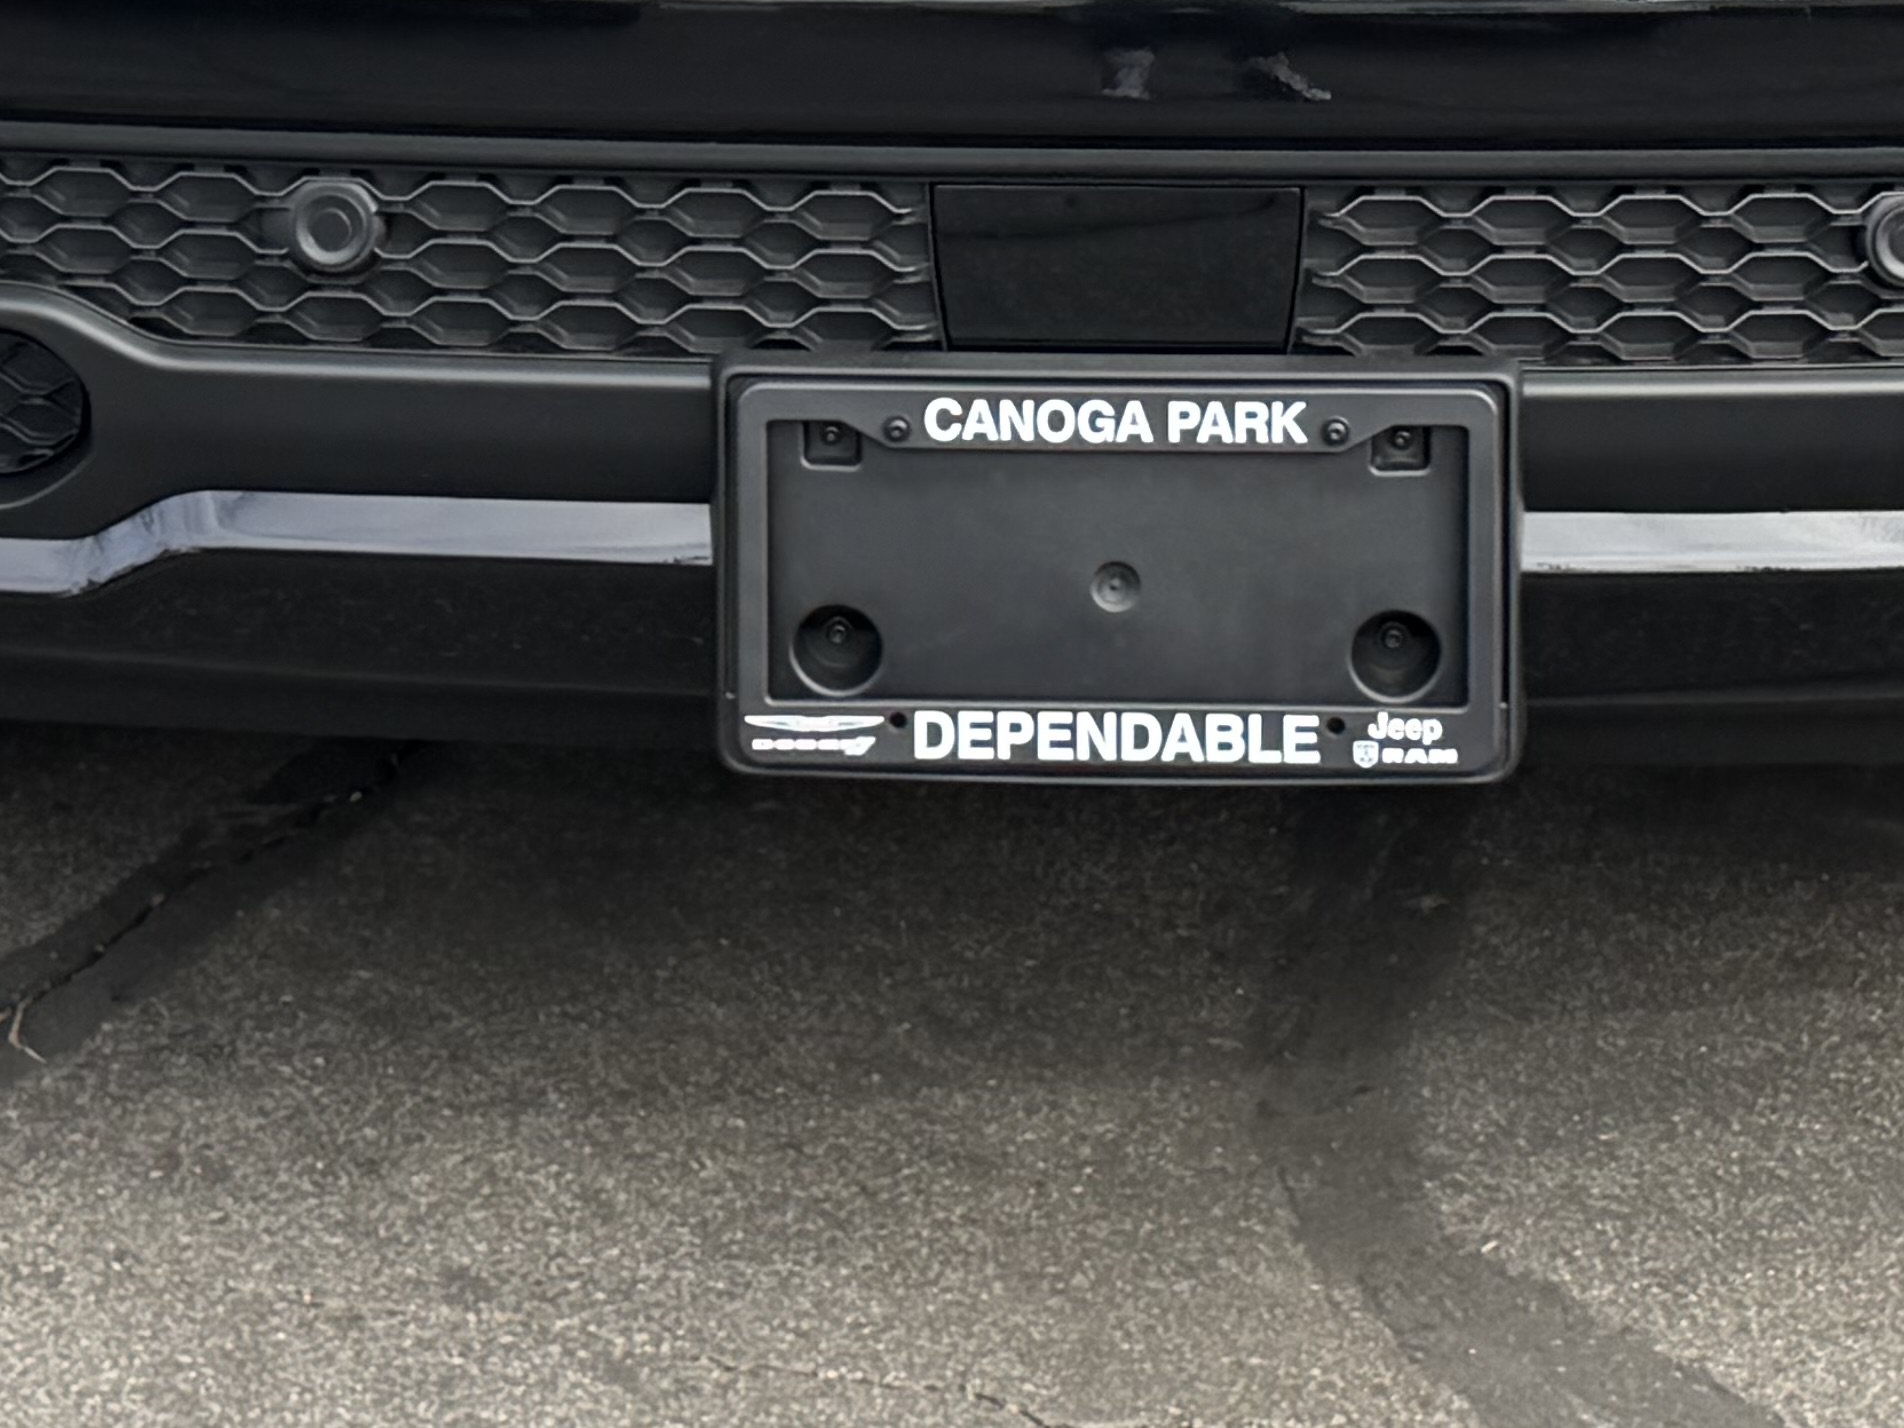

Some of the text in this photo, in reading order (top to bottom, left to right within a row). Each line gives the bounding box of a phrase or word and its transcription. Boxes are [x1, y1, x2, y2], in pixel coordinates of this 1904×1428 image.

[923, 397, 1308, 445] CANOGA PARK
[913, 710, 1321, 765] DEPENDABLE
[1367, 711, 1443, 745] Jeep
